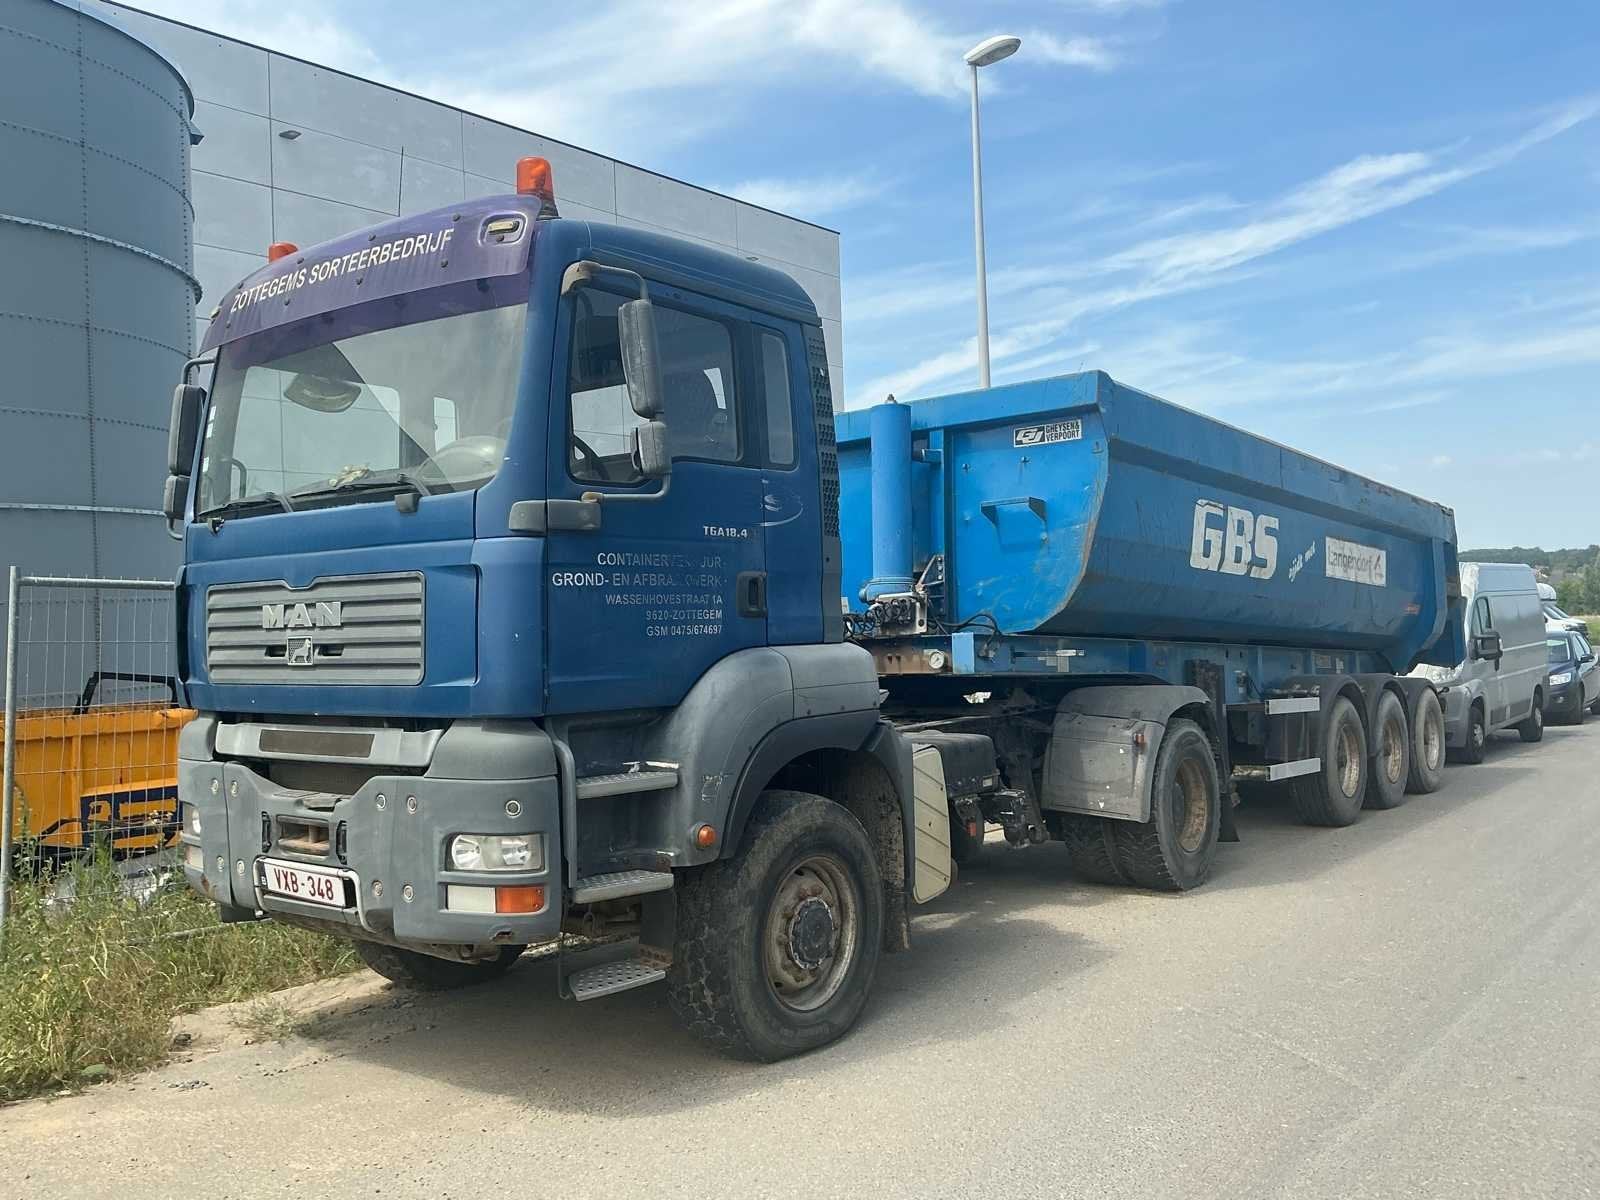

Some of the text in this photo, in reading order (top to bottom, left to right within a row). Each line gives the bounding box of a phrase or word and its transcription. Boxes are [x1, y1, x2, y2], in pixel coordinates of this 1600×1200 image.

[230, 228, 455, 313] ZOTTEGEMS SORTEERBEDRIJF
[1046, 430, 1080, 442] VERPOORT
[1189, 499, 1280, 580] GBS
[551, 572, 609, 587] GROND-
[612, 573, 630, 586] EN
[605, 593, 723, 606] WASSENHOVESTRAAT 1A
[262, 601, 342, 629] MAN
[646, 608, 723, 621] 9620-ZOTTEGEM
[646, 624, 722, 637] GSM 0475/674697
